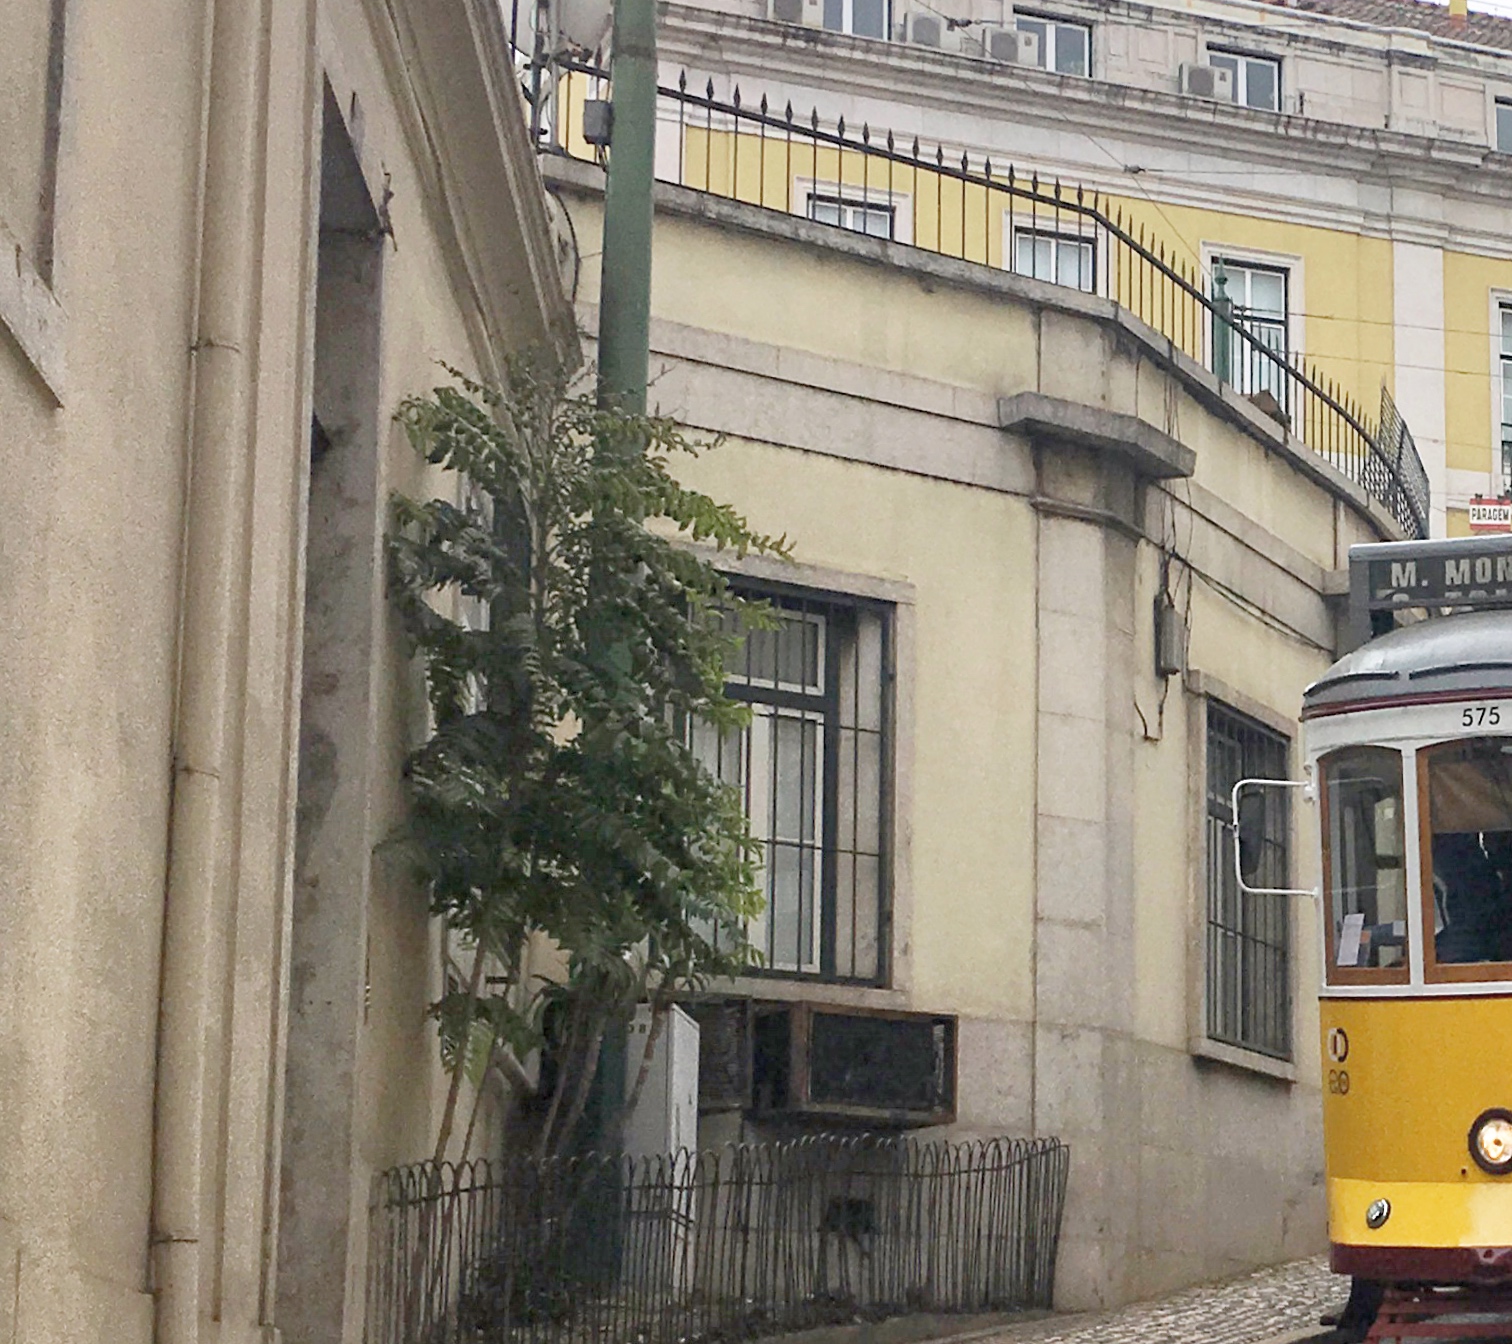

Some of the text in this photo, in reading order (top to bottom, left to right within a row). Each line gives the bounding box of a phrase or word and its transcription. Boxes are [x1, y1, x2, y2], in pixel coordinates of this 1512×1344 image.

[1472, 507, 1509, 521] PARAGEM
[1391, 560, 1428, 588] M.
[1462, 706, 1501, 727] 575
